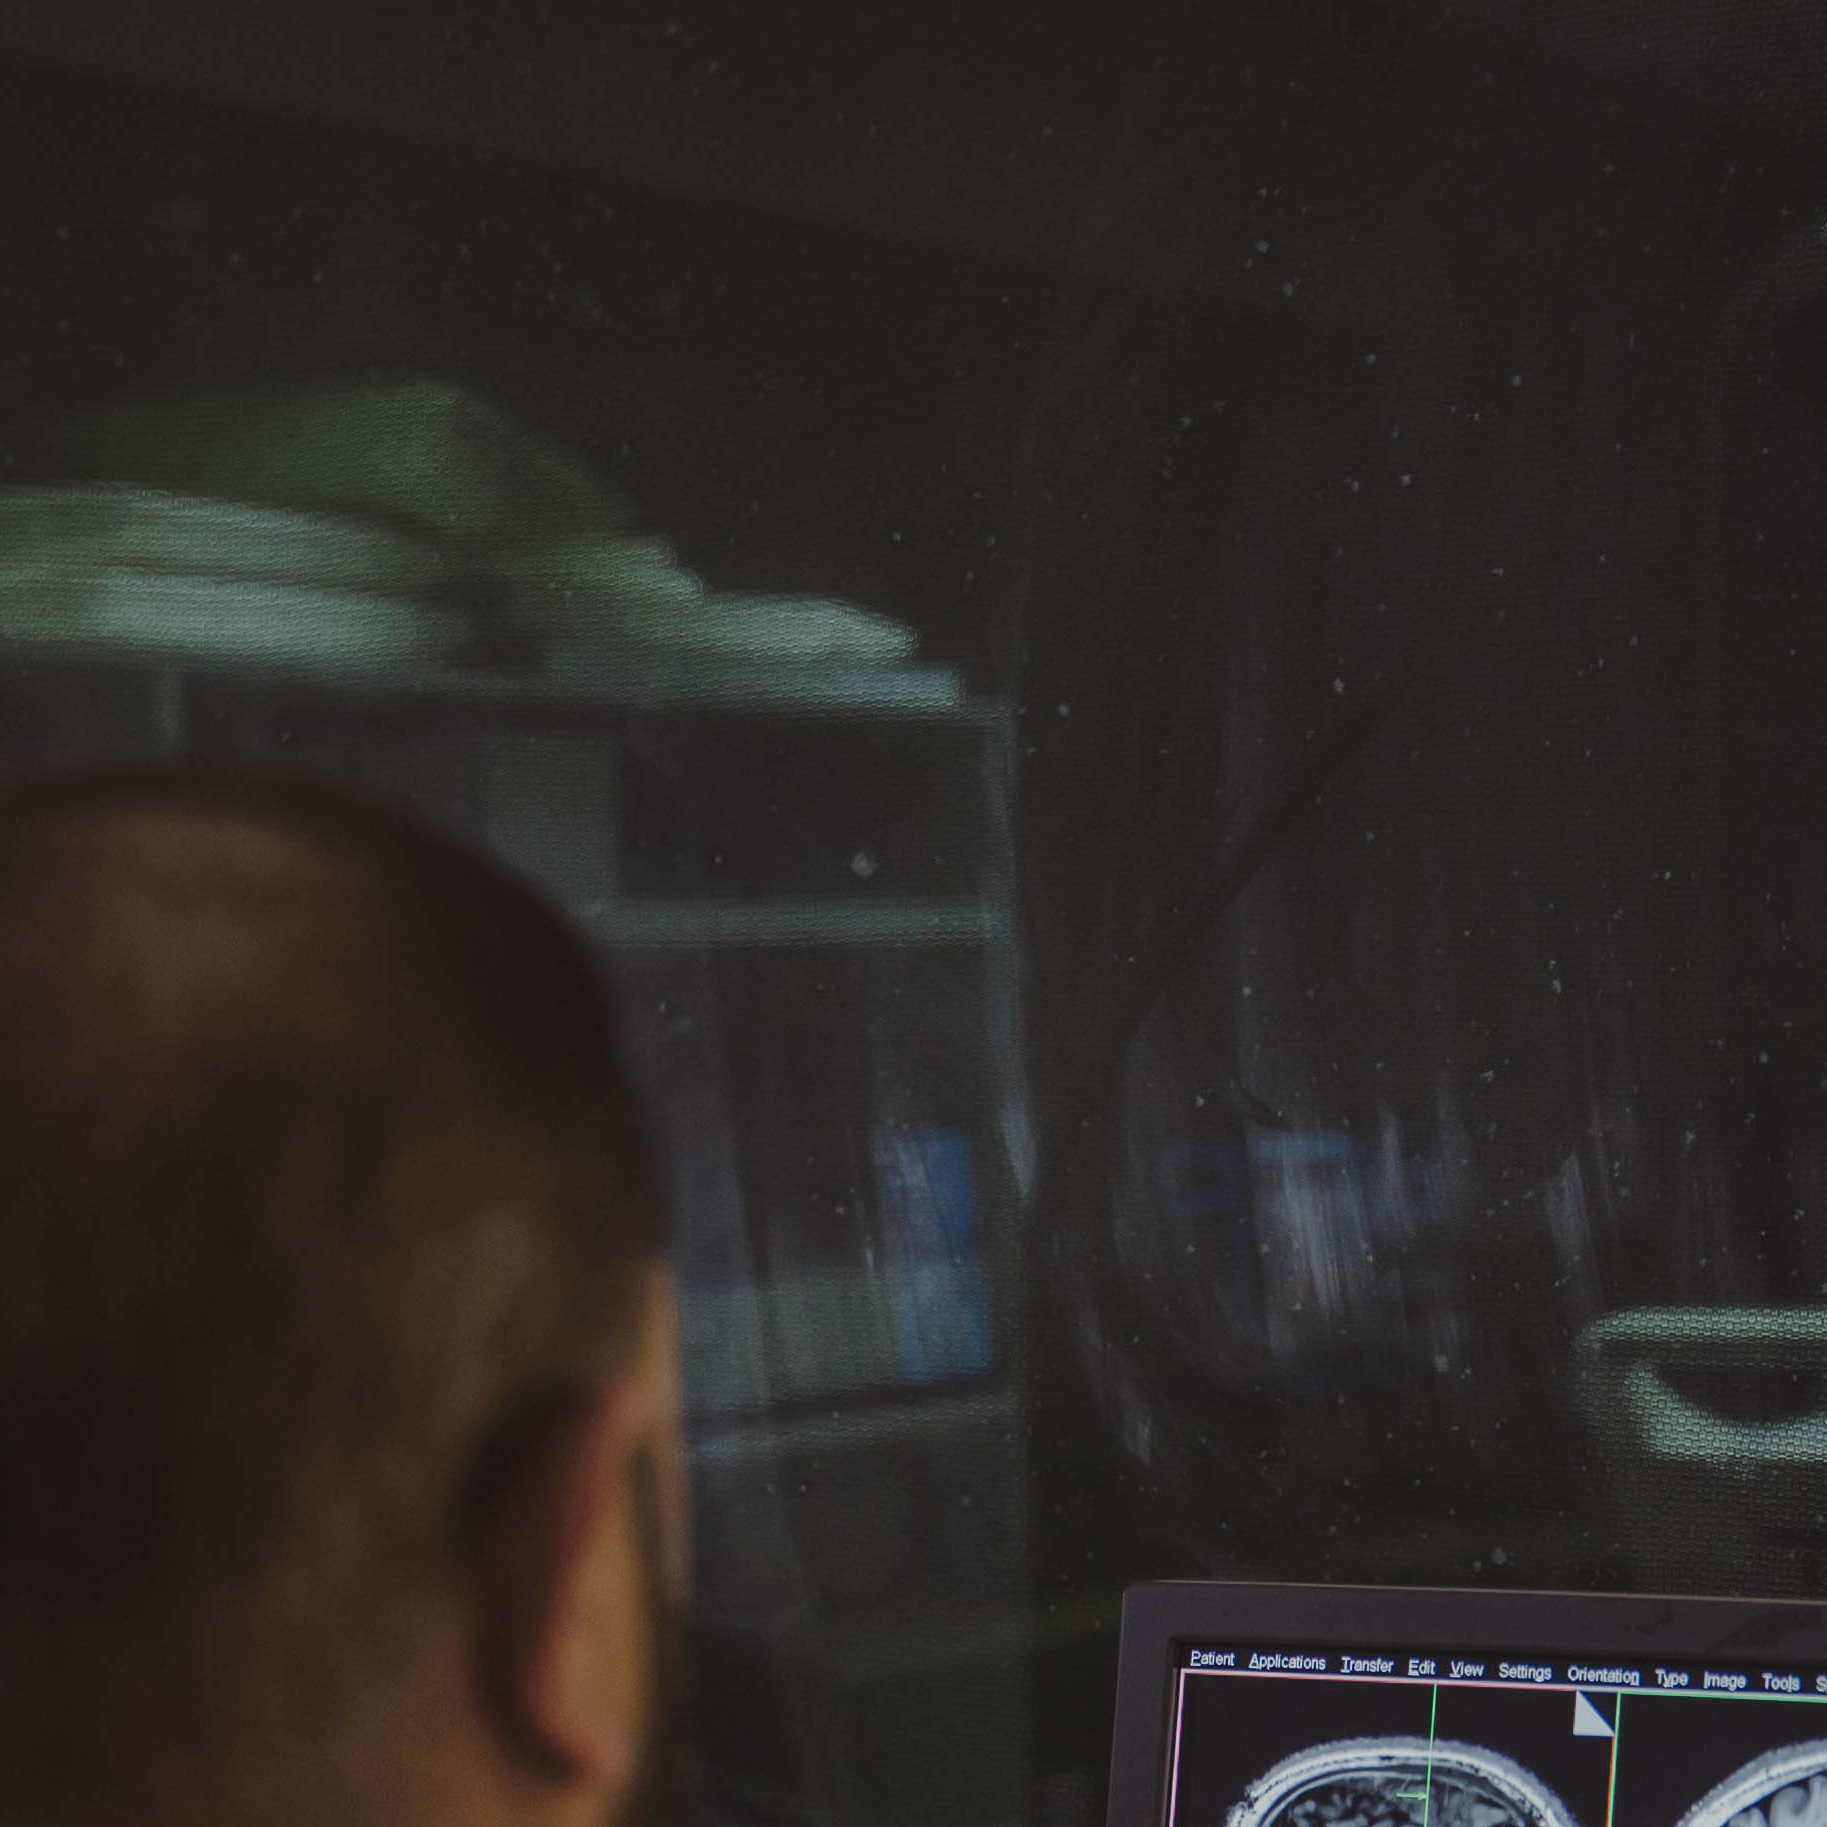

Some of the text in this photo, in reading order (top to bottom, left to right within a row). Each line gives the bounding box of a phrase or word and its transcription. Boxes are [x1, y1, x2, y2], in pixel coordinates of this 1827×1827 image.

[1190, 1651, 1235, 1667] Patient
[1248, 1653, 1327, 1672] Applications
[1341, 1655, 1394, 1674] Transfer
[1408, 1659, 1436, 1676] Edit
[1450, 1661, 1485, 1678] View
[1499, 1662, 1552, 1682] Settings
[1567, 1665, 1640, 1686] Orientation
[1655, 1668, 1689, 1688] Type
[1704, 1671, 1748, 1691] Image
[1762, 1673, 1800, 1692] Tools
